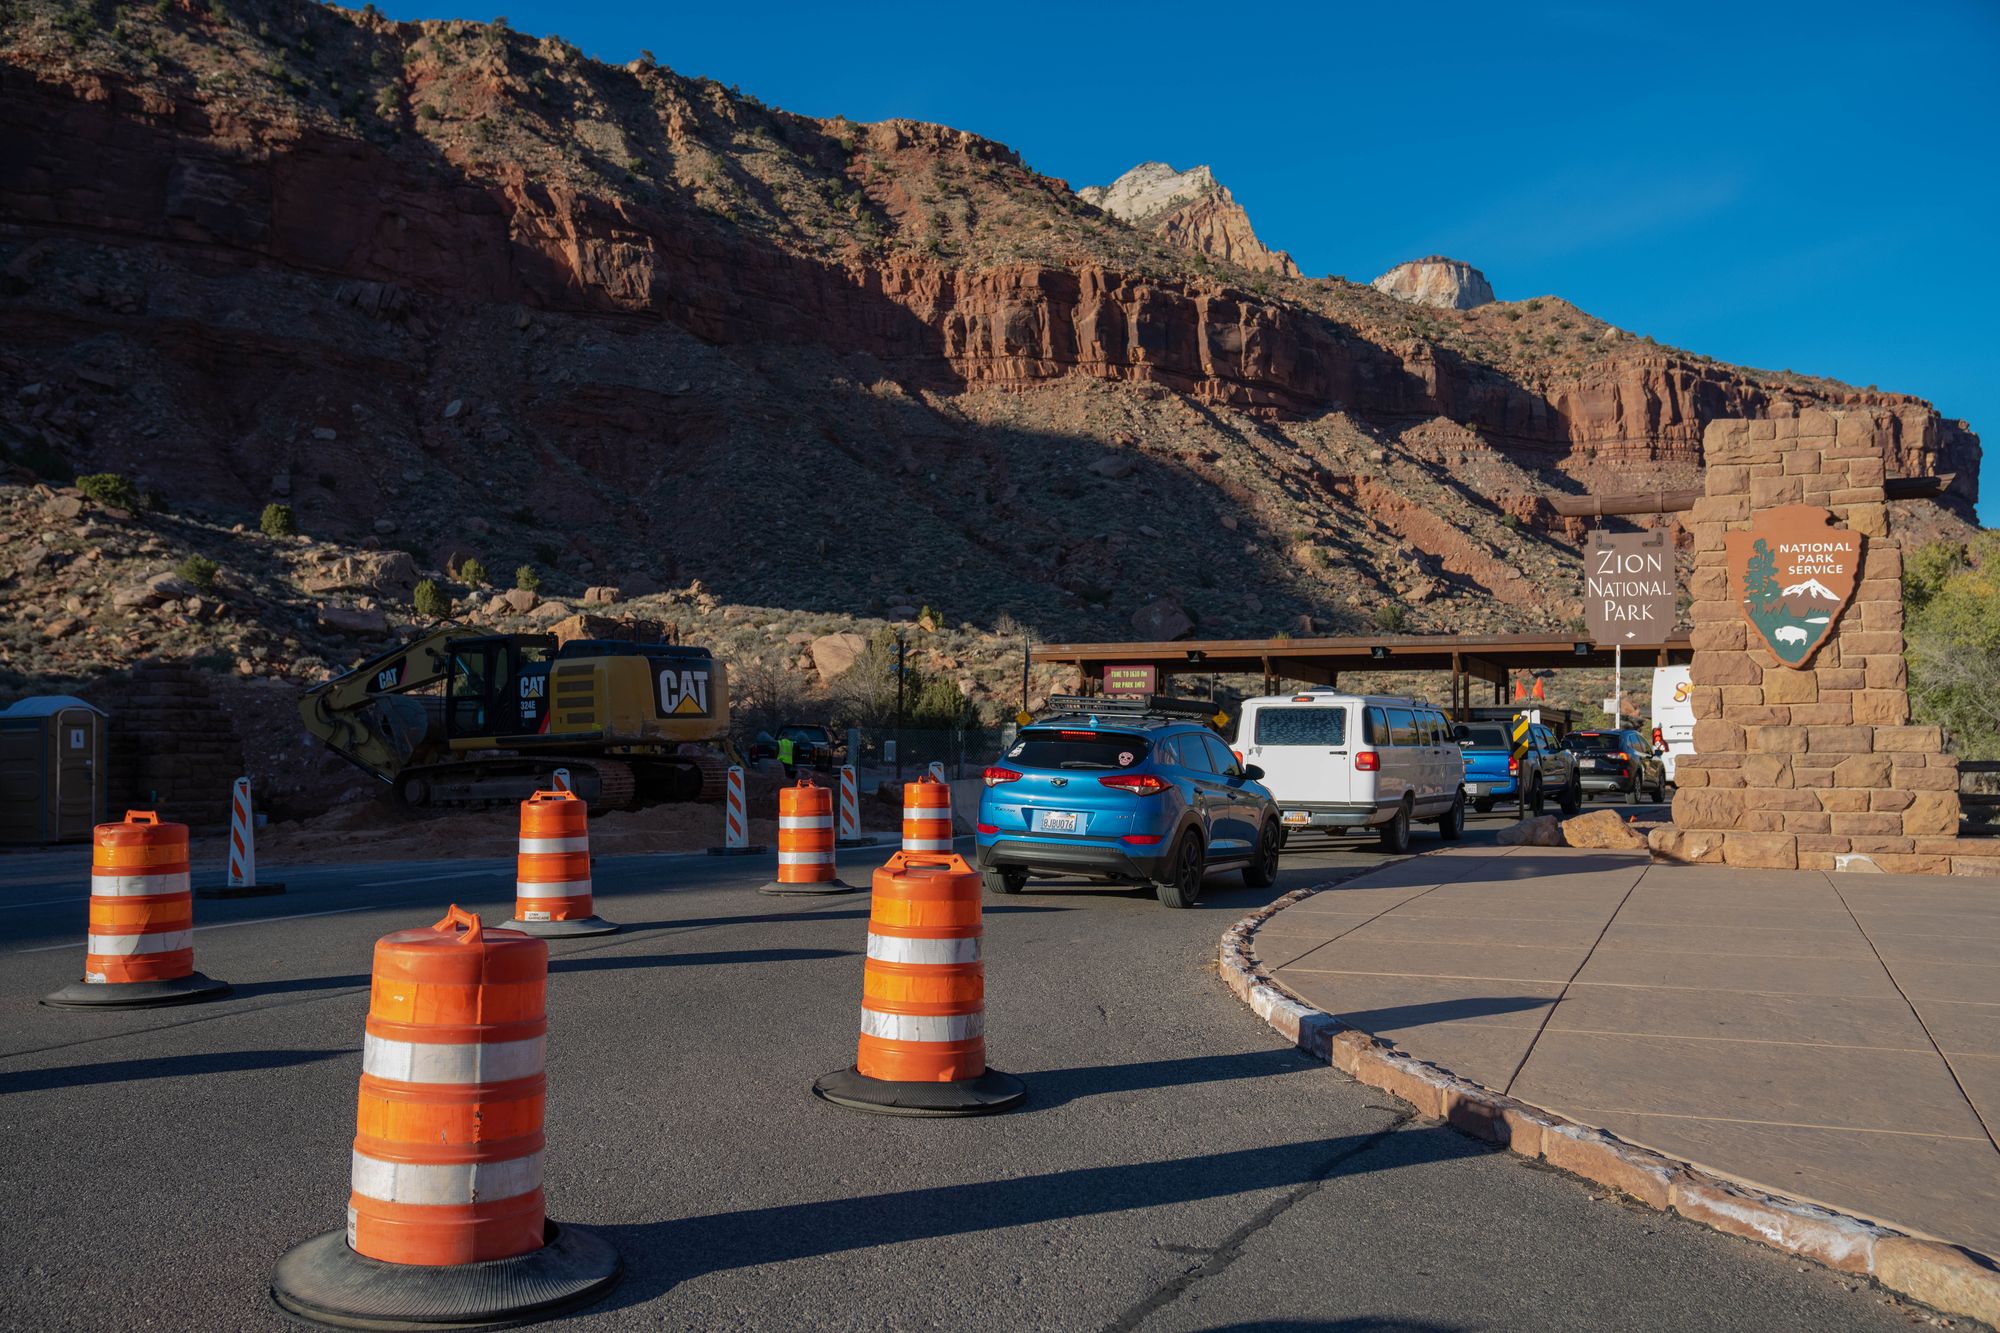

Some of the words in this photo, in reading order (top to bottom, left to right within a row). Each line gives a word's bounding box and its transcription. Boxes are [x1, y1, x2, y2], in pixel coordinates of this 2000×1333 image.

[1779, 542, 1853, 553] NATIONAL
[1797, 554, 1834, 563] PARK
[1596, 550, 1662, 575] ZION
[1788, 564, 1844, 575] SERVICE
[1588, 577, 1672, 598] NATIONAL
[1604, 600, 1655, 622] PARK
[378, 667, 398, 689] CAT
[520, 675, 546, 698] CAT
[659, 669, 708, 714] CAT
